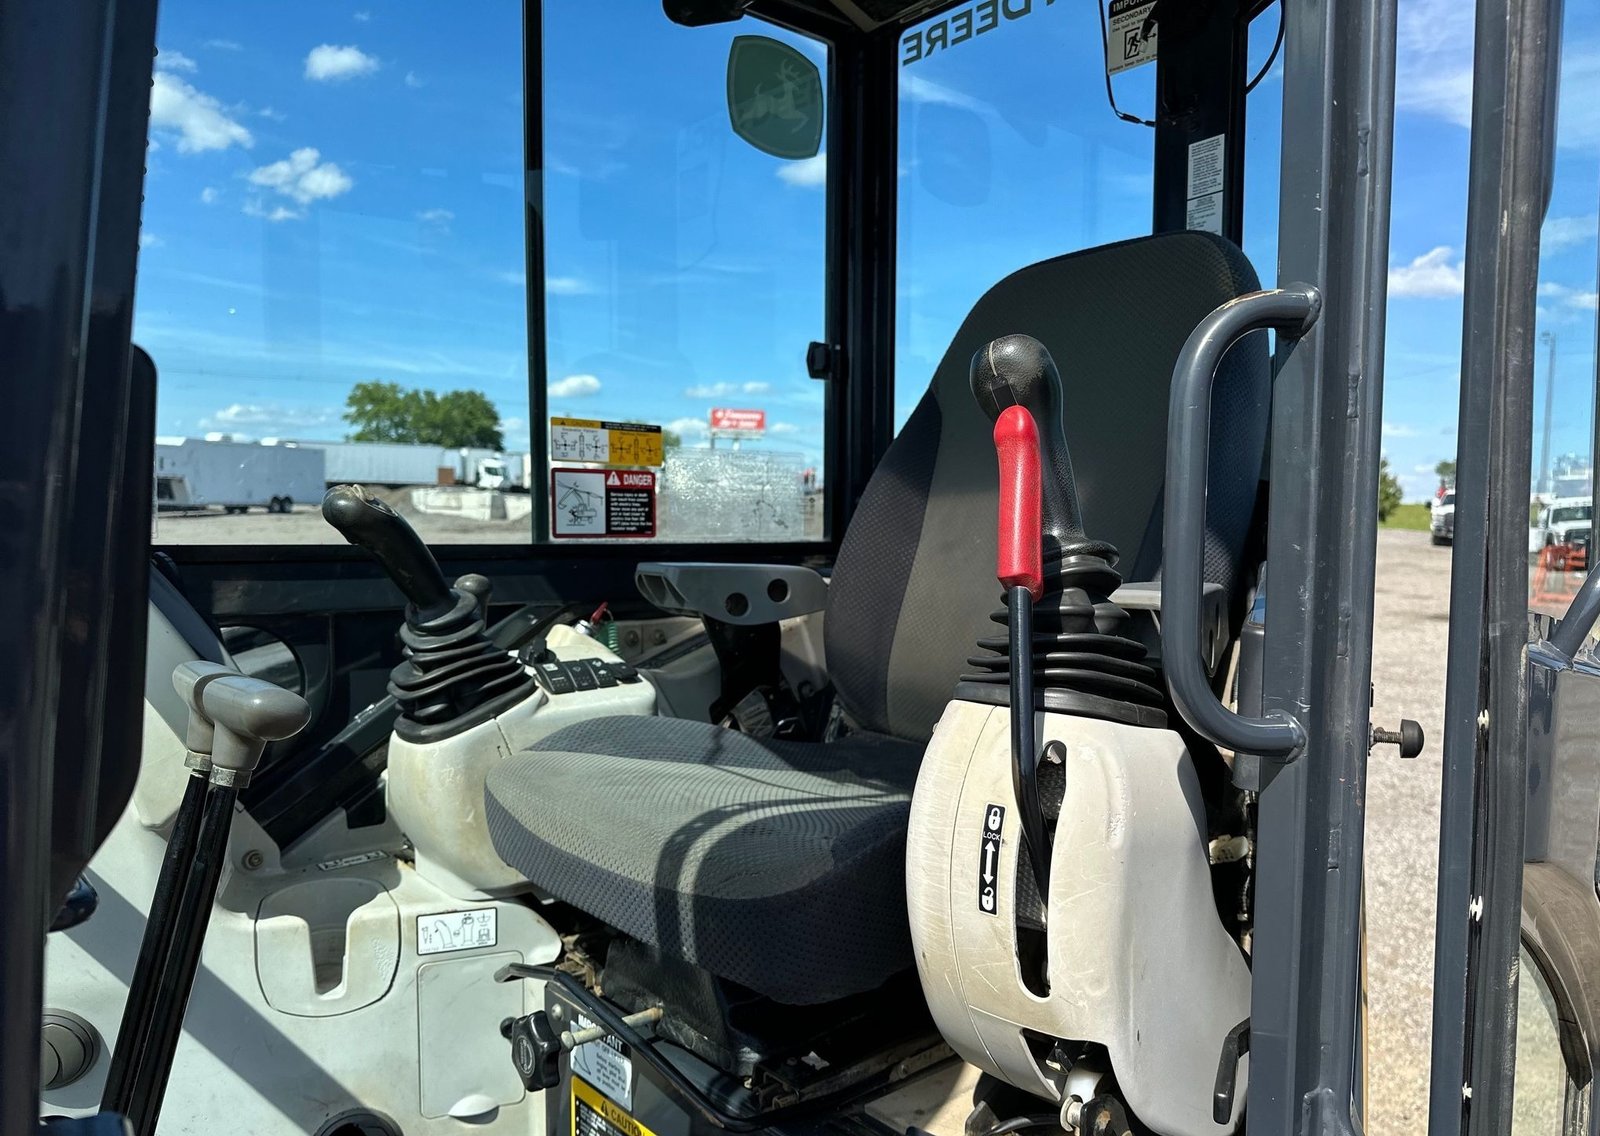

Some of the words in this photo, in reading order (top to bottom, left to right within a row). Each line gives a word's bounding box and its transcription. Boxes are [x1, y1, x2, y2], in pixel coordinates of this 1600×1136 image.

[1113, 5, 1151, 26] SECONDARY
[623, 474, 653, 486] DANGER
[983, 831, 1001, 841] LOCK
[611, 1109, 647, 1136] CAUTIO
